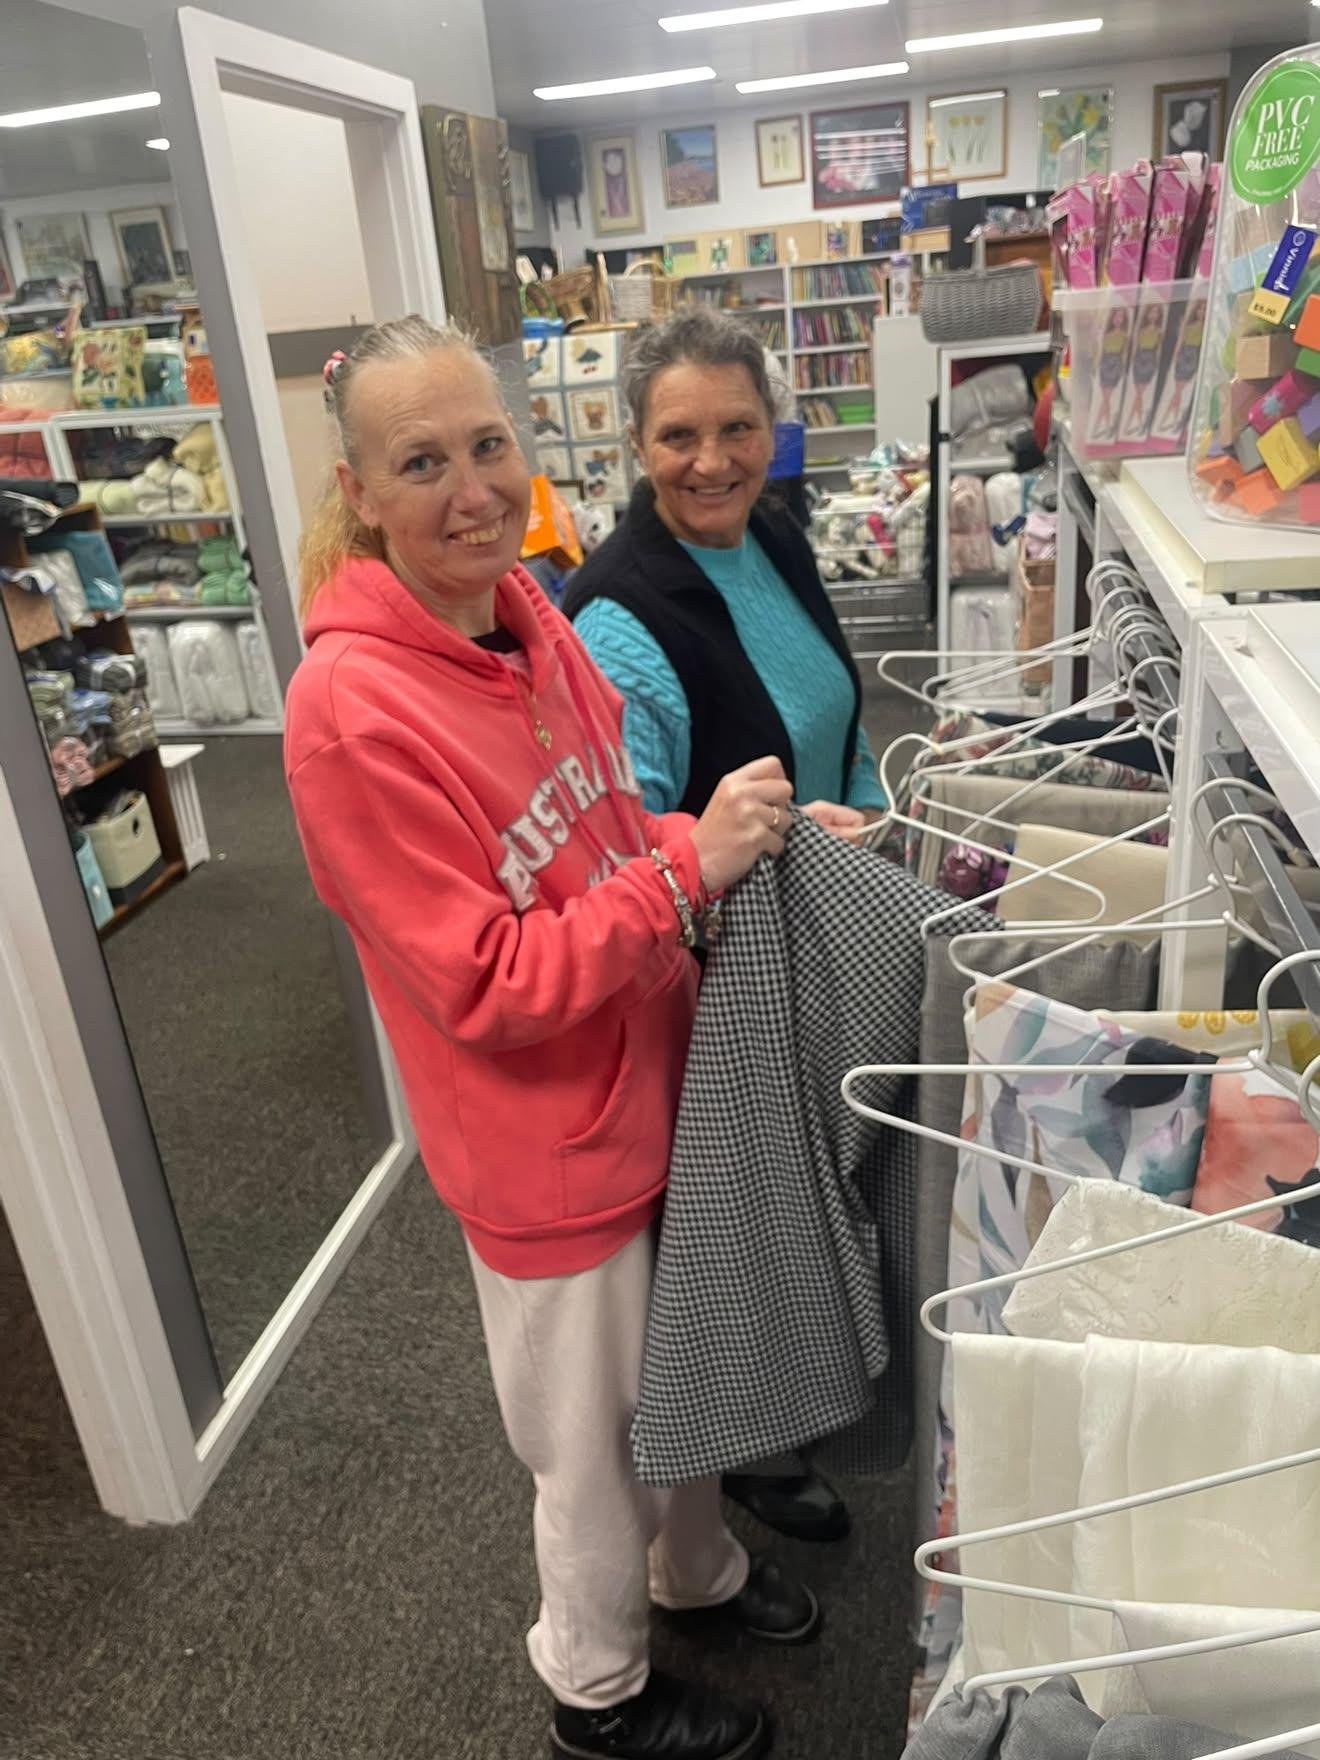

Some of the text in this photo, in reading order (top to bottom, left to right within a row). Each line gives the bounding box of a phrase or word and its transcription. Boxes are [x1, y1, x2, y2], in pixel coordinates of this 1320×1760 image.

[1258, 95, 1315, 134] PVC
[1251, 126, 1305, 158] FREE
[1244, 152, 1300, 172] PACKAGING
